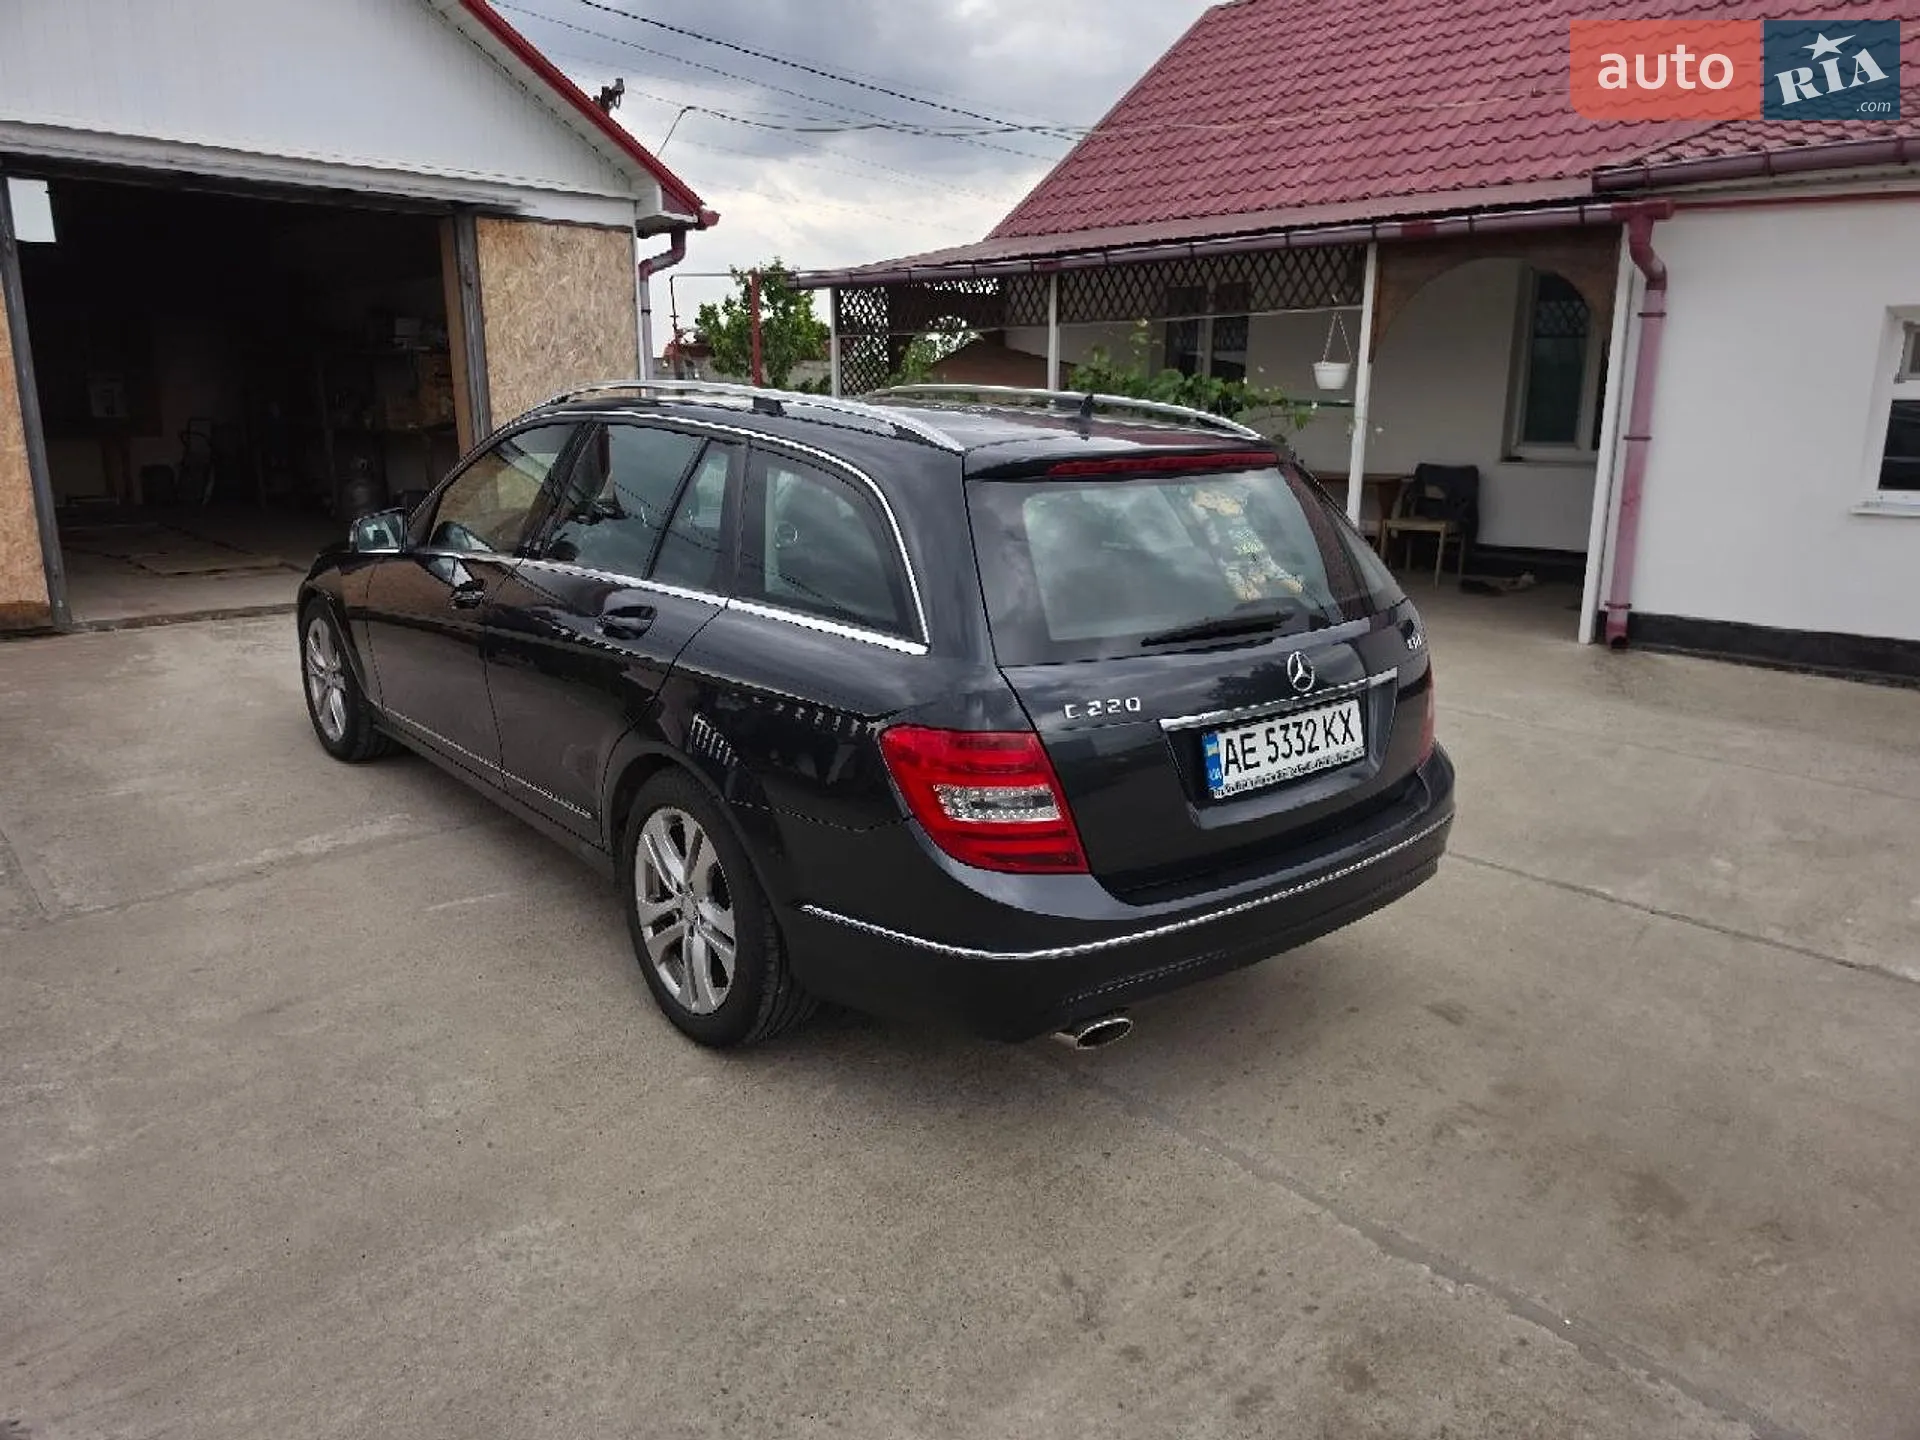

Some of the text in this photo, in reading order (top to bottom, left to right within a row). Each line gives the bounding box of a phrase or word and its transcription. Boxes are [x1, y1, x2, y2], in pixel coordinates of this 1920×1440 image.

[1064, 696, 1141, 719] C 220
[1225, 732, 1261, 777] AE
[1265, 718, 1320, 764] 5332
[1322, 708, 1356, 748] KX
